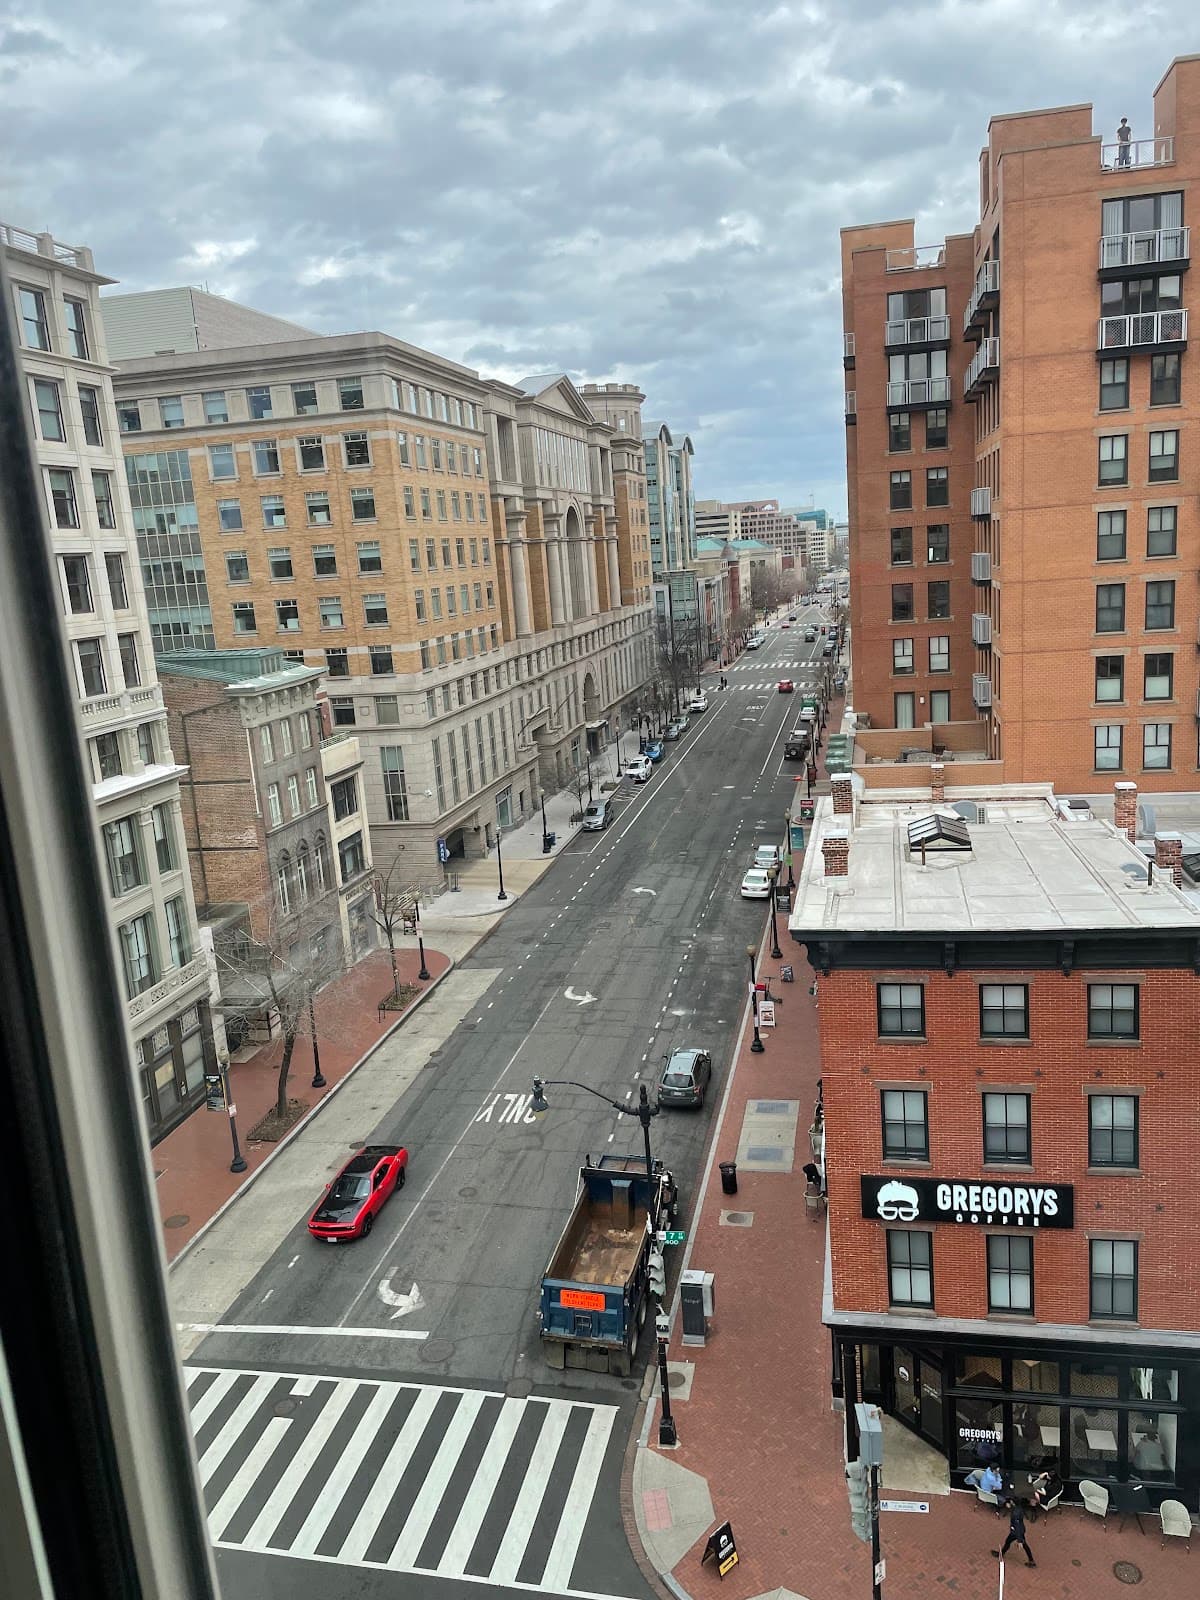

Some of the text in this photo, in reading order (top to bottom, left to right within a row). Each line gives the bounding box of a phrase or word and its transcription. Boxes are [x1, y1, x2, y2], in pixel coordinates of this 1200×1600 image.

[936, 1184, 1059, 1216] GREGORYS
[956, 1213, 1040, 1226] COFFEE
[959, 1428, 1001, 1440] GREGORYS
